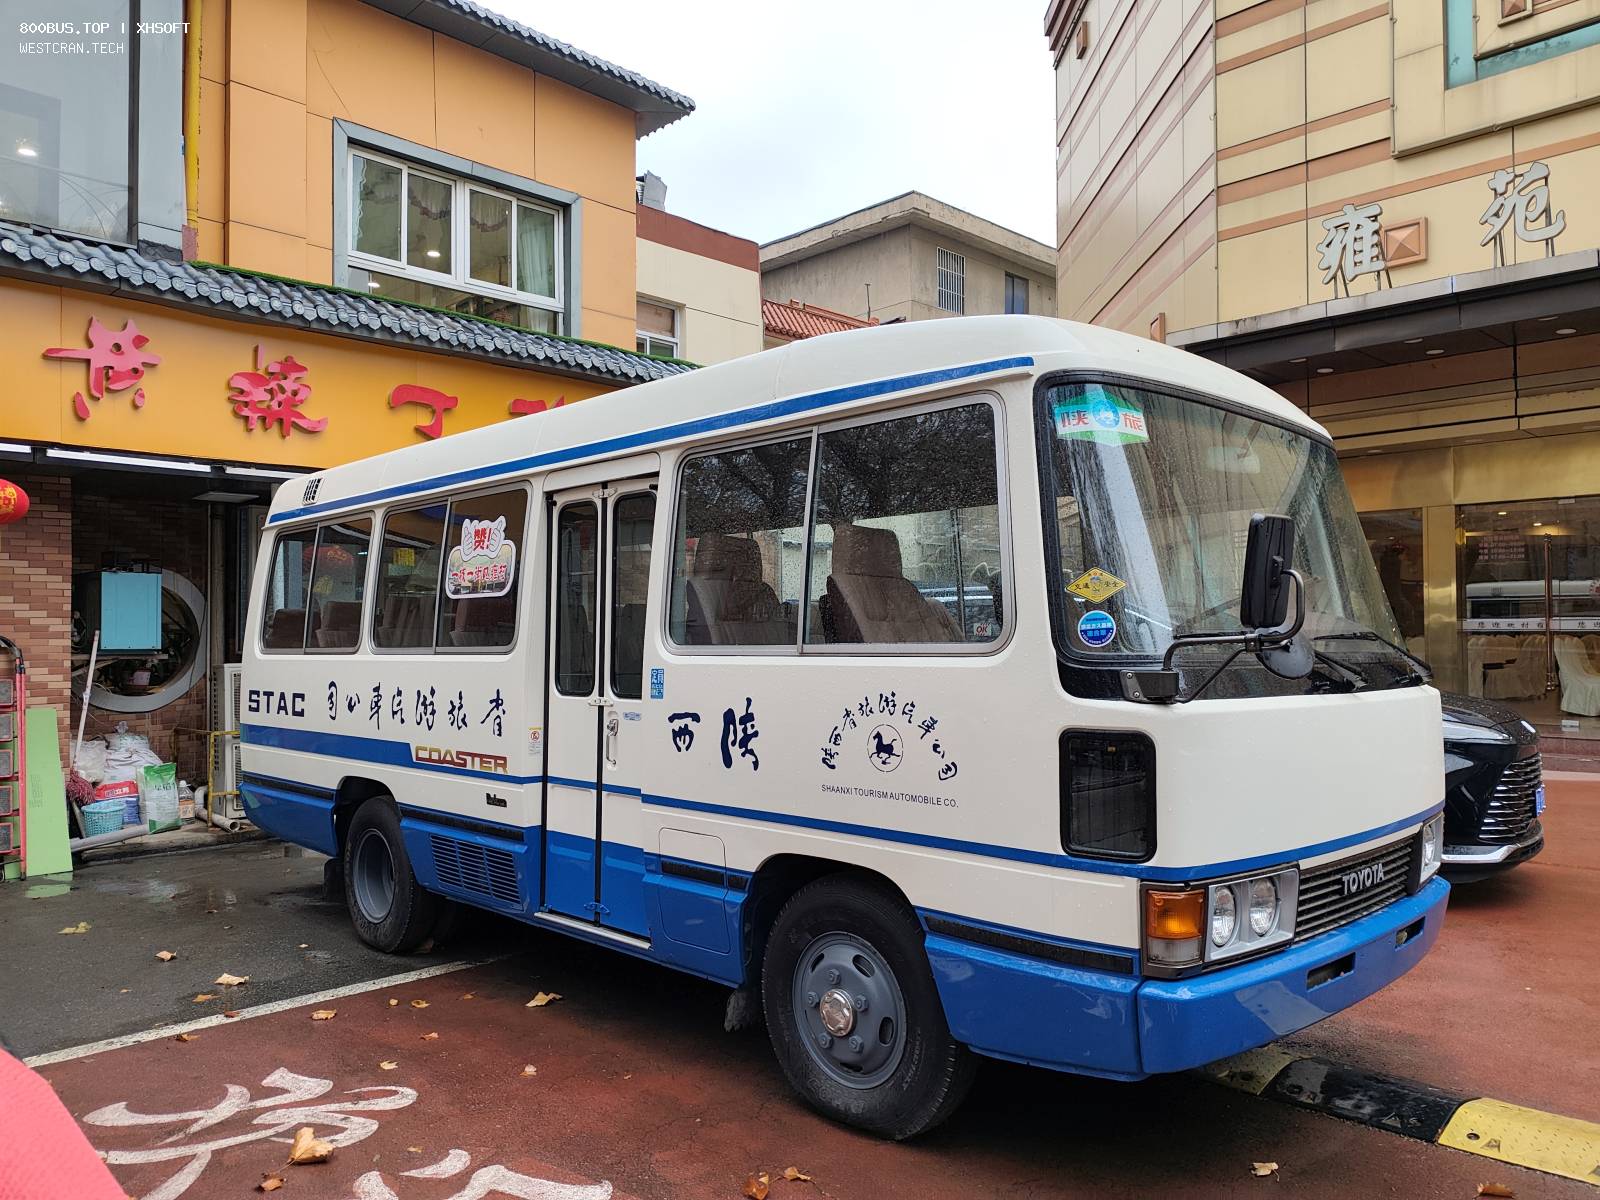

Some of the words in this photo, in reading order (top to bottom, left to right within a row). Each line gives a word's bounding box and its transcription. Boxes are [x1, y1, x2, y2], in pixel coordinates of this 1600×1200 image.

[248, 689, 306, 718] STAC
[415, 745, 509, 775] COASTER
[821, 784, 853, 796] SHAANXI
[854, 787, 888, 800] TOURISM
[889, 792, 942, 807] AUTOMOBILE
[943, 798, 959, 809] CO.
[1342, 863, 1385, 896] TOYOTA
